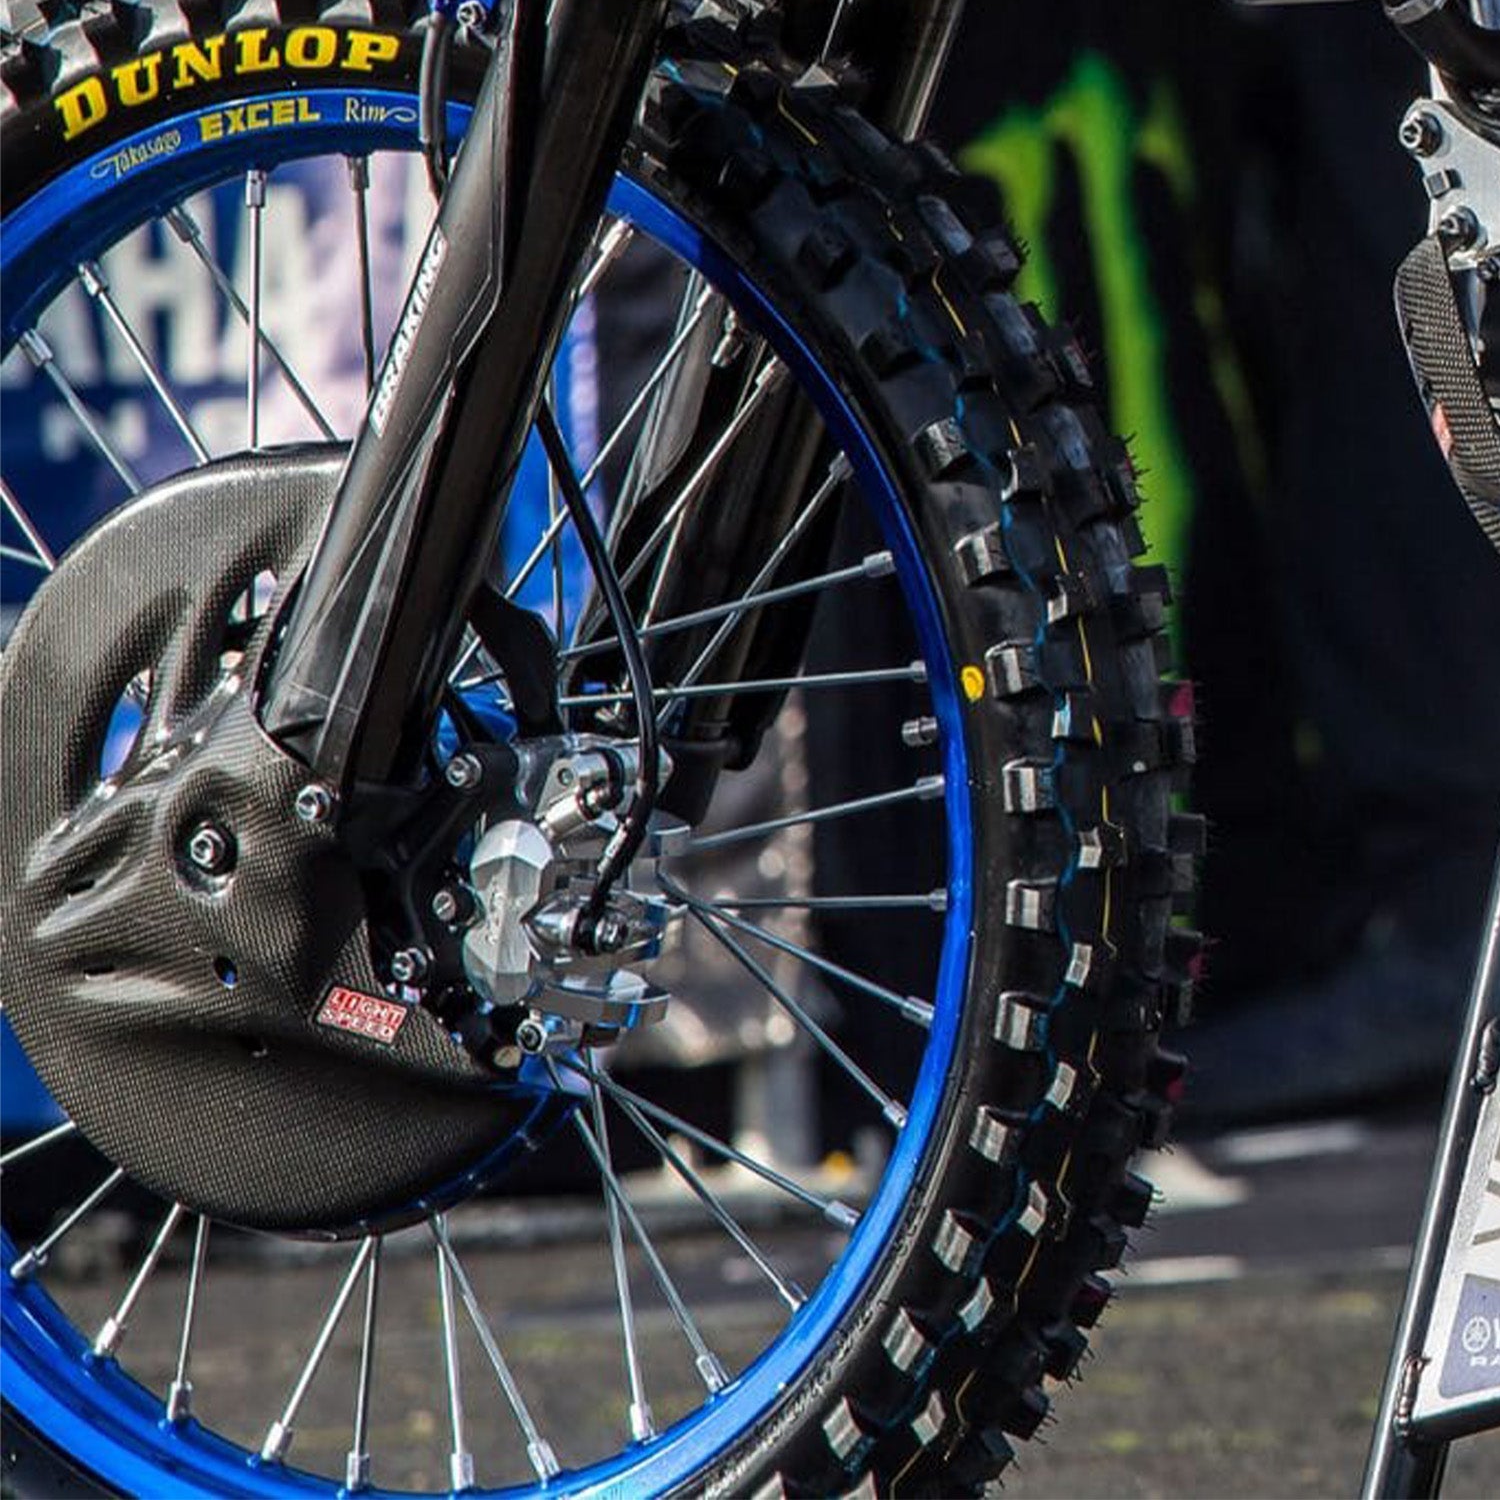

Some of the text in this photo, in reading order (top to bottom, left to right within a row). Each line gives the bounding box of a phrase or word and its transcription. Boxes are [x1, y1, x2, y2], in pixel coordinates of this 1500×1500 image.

[53, 26, 400, 141] DUNLOP
[91, 95, 418, 180] Takasago EXCEL Rim
